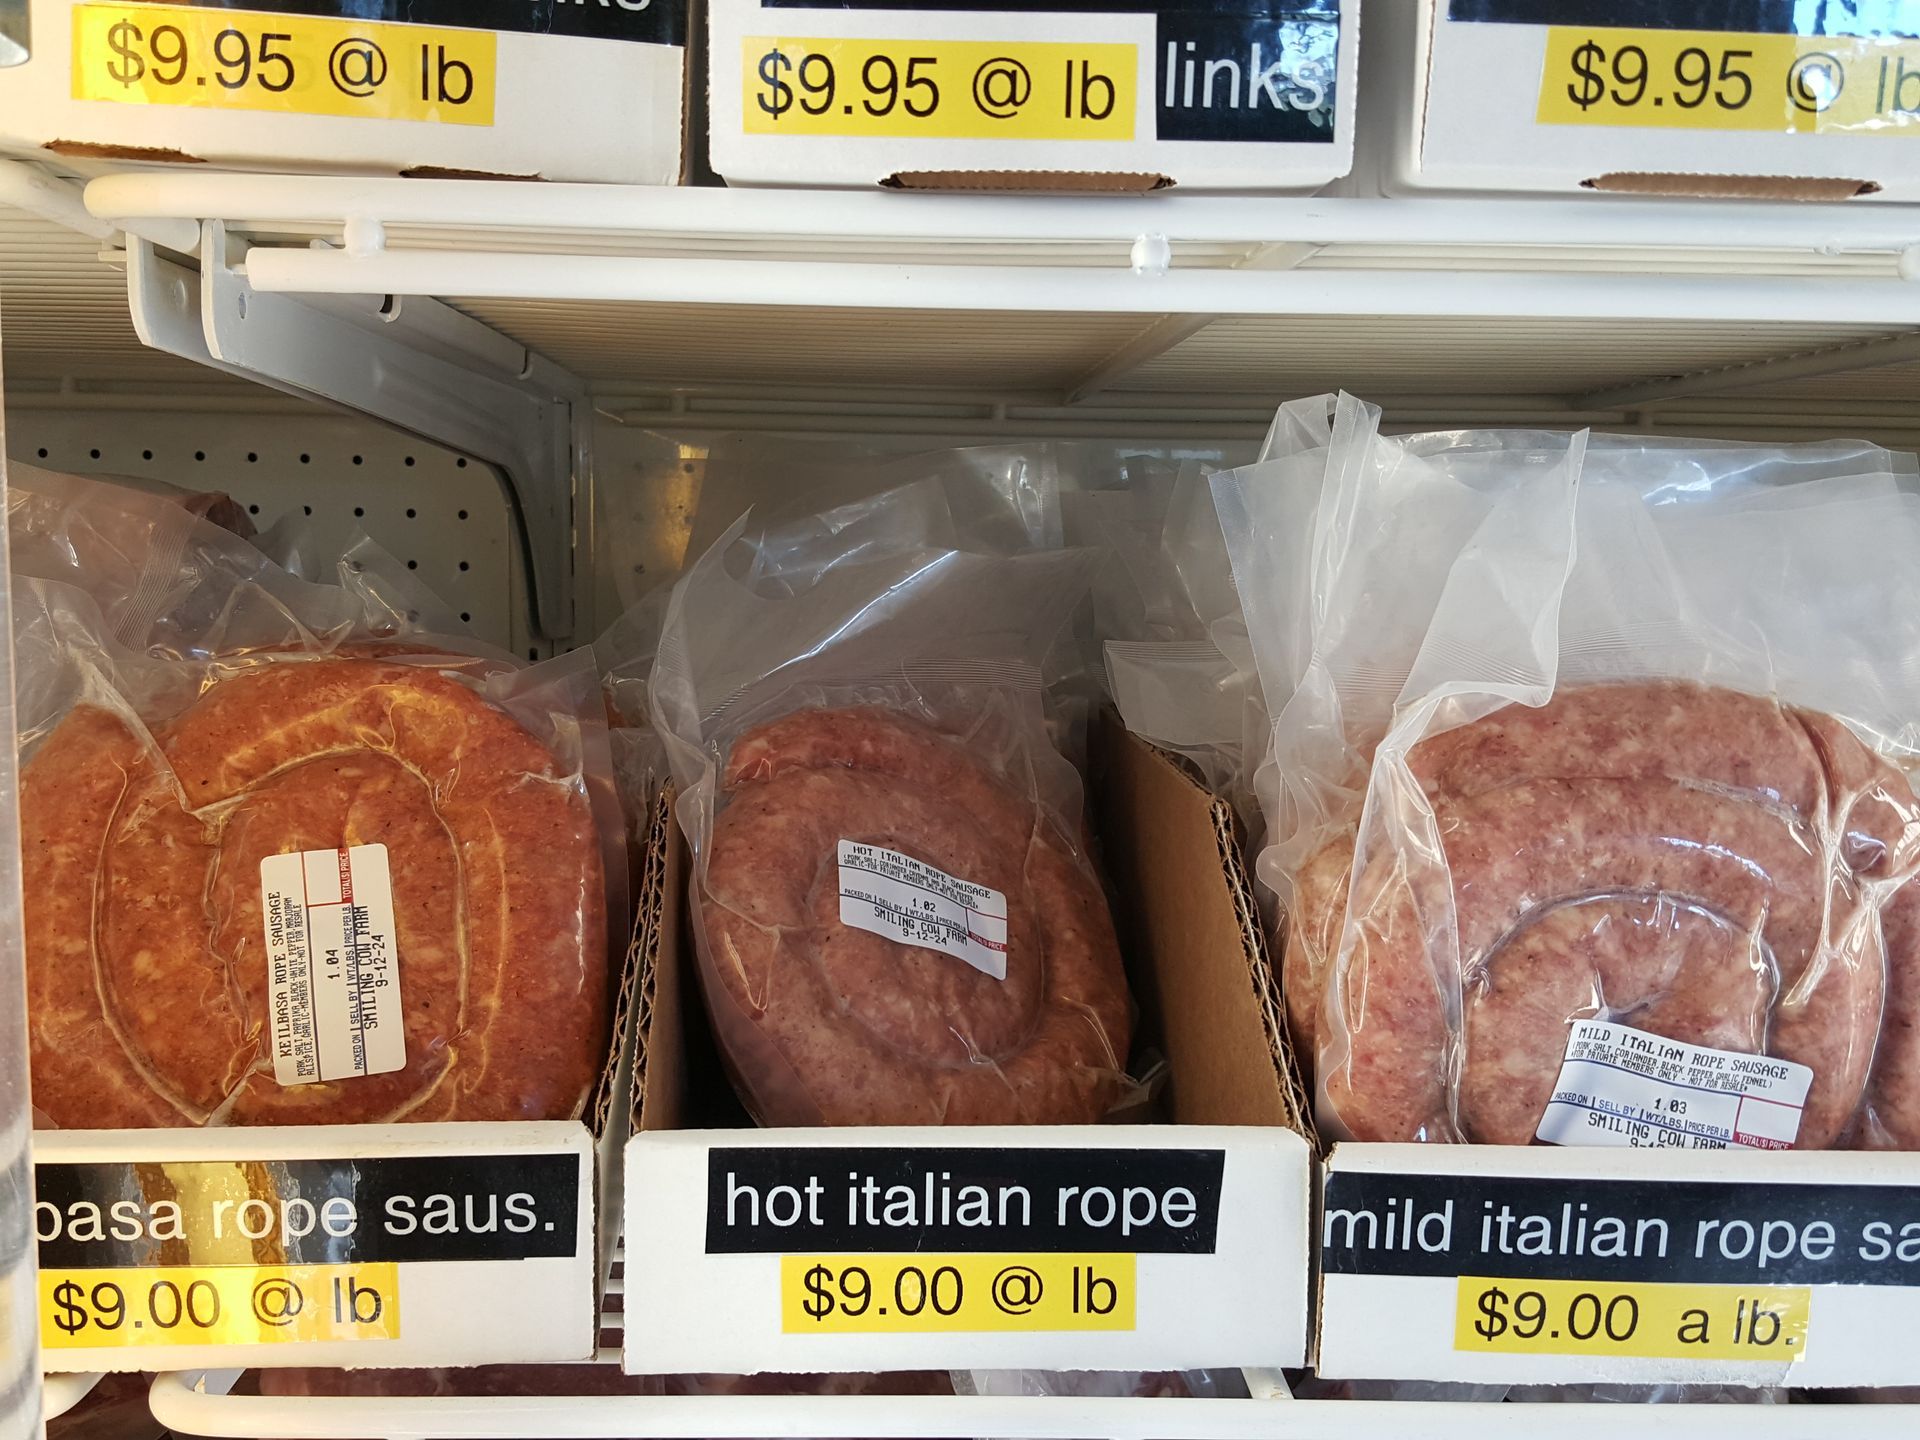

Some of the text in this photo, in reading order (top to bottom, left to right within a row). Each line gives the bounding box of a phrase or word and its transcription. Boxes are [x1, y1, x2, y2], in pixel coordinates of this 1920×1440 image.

[107, 18, 473, 105] $9.95 @ lb
[1165, 41, 1325, 110] links
[1567, 40, 1753, 112] $9.95
[1786, 51, 1844, 113] @
[757, 47, 1115, 122] $9.95 @ lb
[340, 852, 350, 871] PRICE
[853, 845, 991, 899] HOT ITALIAN ROPE SAUSAGE
[343, 915, 352, 926] PER
[845, 889, 864, 898] PACKED
[879, 898, 893, 909] SELL
[894, 904, 903, 912] BY
[912, 897, 936, 912] 1.02
[344, 927, 353, 943] PRICE
[874, 906, 967, 946] SMILING COW FARM
[903, 928, 947, 946] 9-12-24
[269, 892, 292, 1057] KEILBASA ROPE SAUSAGE
[325, 949, 340, 979] 1.04
[354, 905, 378, 1029] SMILING COW FARM
[371, 935, 388, 987] 9-12-24
[348, 990, 357, 1001] BY
[350, 1003, 359, 1024] SELL
[352, 1034, 360, 1043] ON
[353, 1045, 363, 1069] PACKED
[1578, 1027, 1788, 1080] MILD ITALIAN ROPE SAUSAGE
[1621, 1059, 1655, 1075] MEMBERS
[1658, 1069, 1678, 1081] ONLY
[1555, 1091, 1576, 1102] PACKED
[1577, 1094, 1588, 1105] ON
[1598, 1099, 1621, 1113] SELL
[1623, 1106, 1636, 1116] BY
[1688, 1121, 1705, 1133] PRICE
[1706, 1125, 1719, 1135] PER
[1654, 1098, 1687, 1114] 1.03
[1588, 1112, 1650, 1139] SMILING
[1658, 1129, 1686, 1147] COW
[1692, 1136, 1727, 1150] FARM
[1768, 1140, 1789, 1151] PRICE
[212, 1196, 358, 1246] rope
[384, 1191, 555, 1235] saus.
[726, 1172, 1197, 1236] hot italian rope
[1323, 1198, 1453, 1253] mild
[1481, 1201, 1669, 1258] italian
[1695, 1220, 1835, 1268] rope
[52, 1276, 382, 1335] $9.00 @ lb
[802, 1264, 1117, 1321] $9.00 @ lb
[1474, 1287, 1795, 1346] $9.00 a lb.
